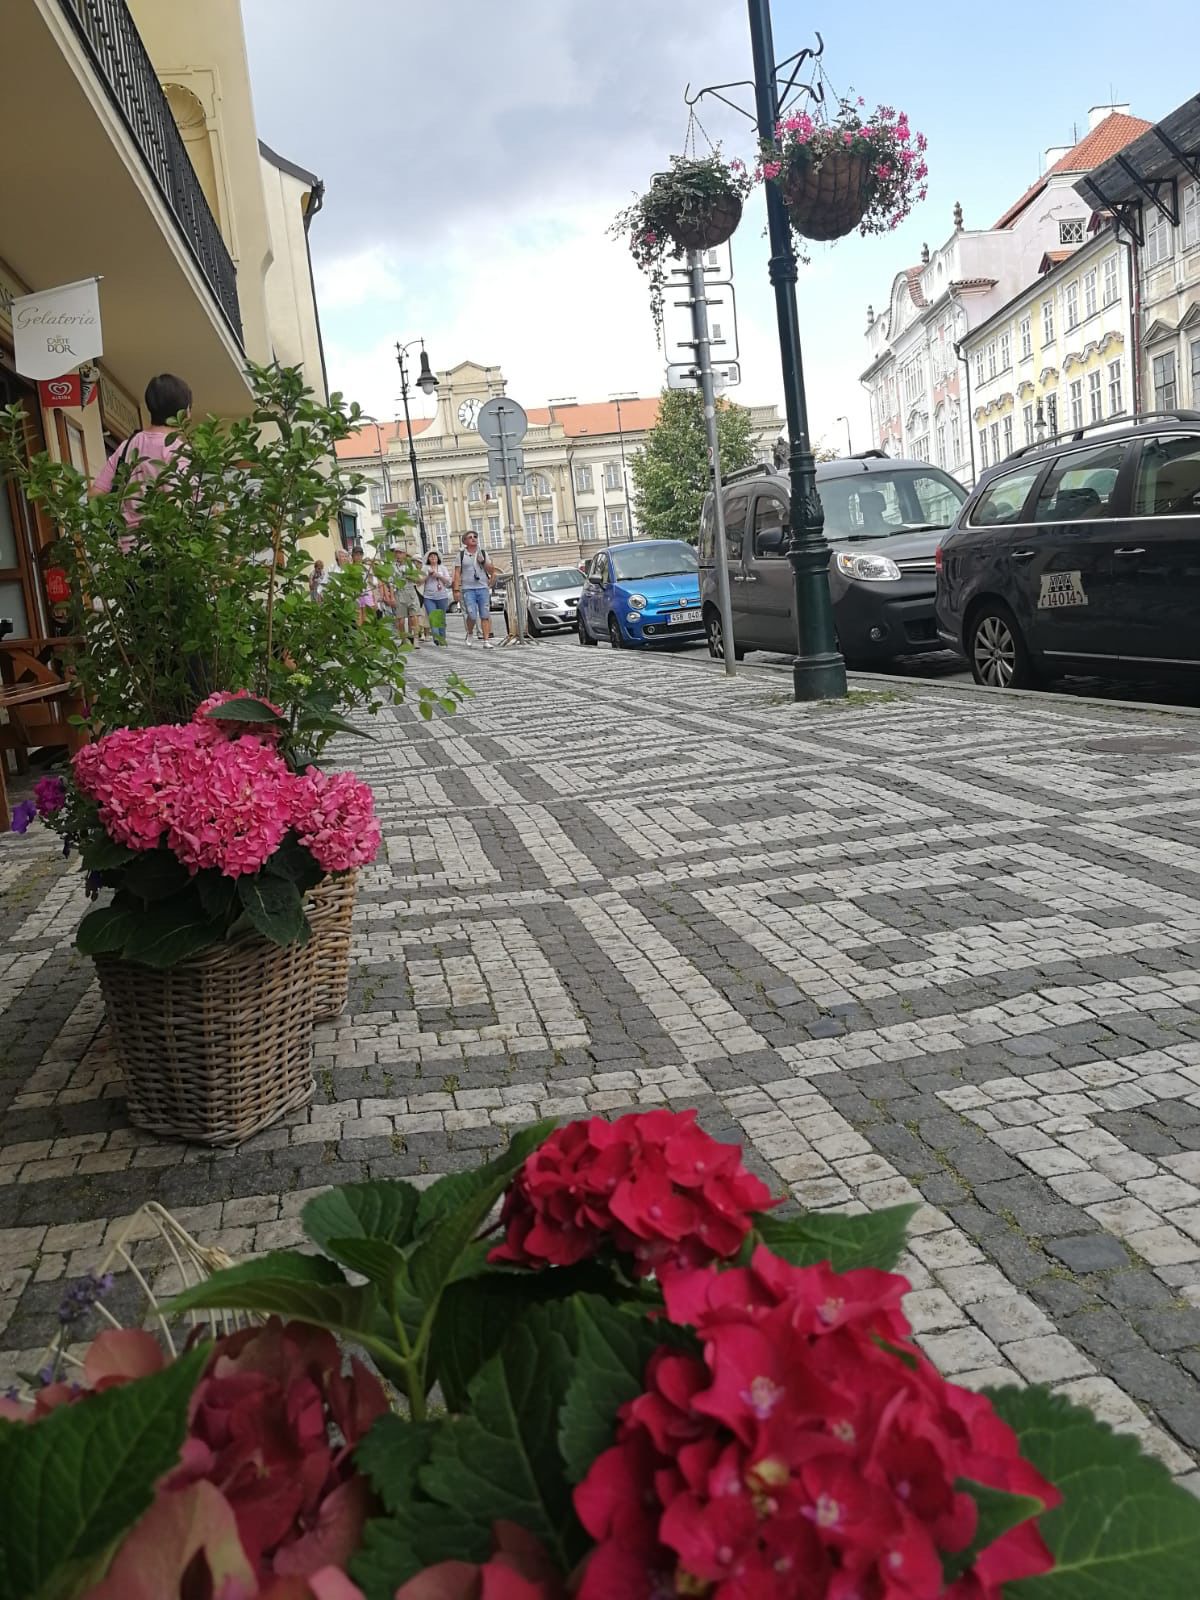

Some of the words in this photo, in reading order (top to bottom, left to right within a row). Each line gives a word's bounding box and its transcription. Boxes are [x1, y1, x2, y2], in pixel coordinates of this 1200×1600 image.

[16, 306, 96, 330] Gelateria
[47, 344, 77, 356] D'OR
[1048, 591, 1077, 606] 14014
